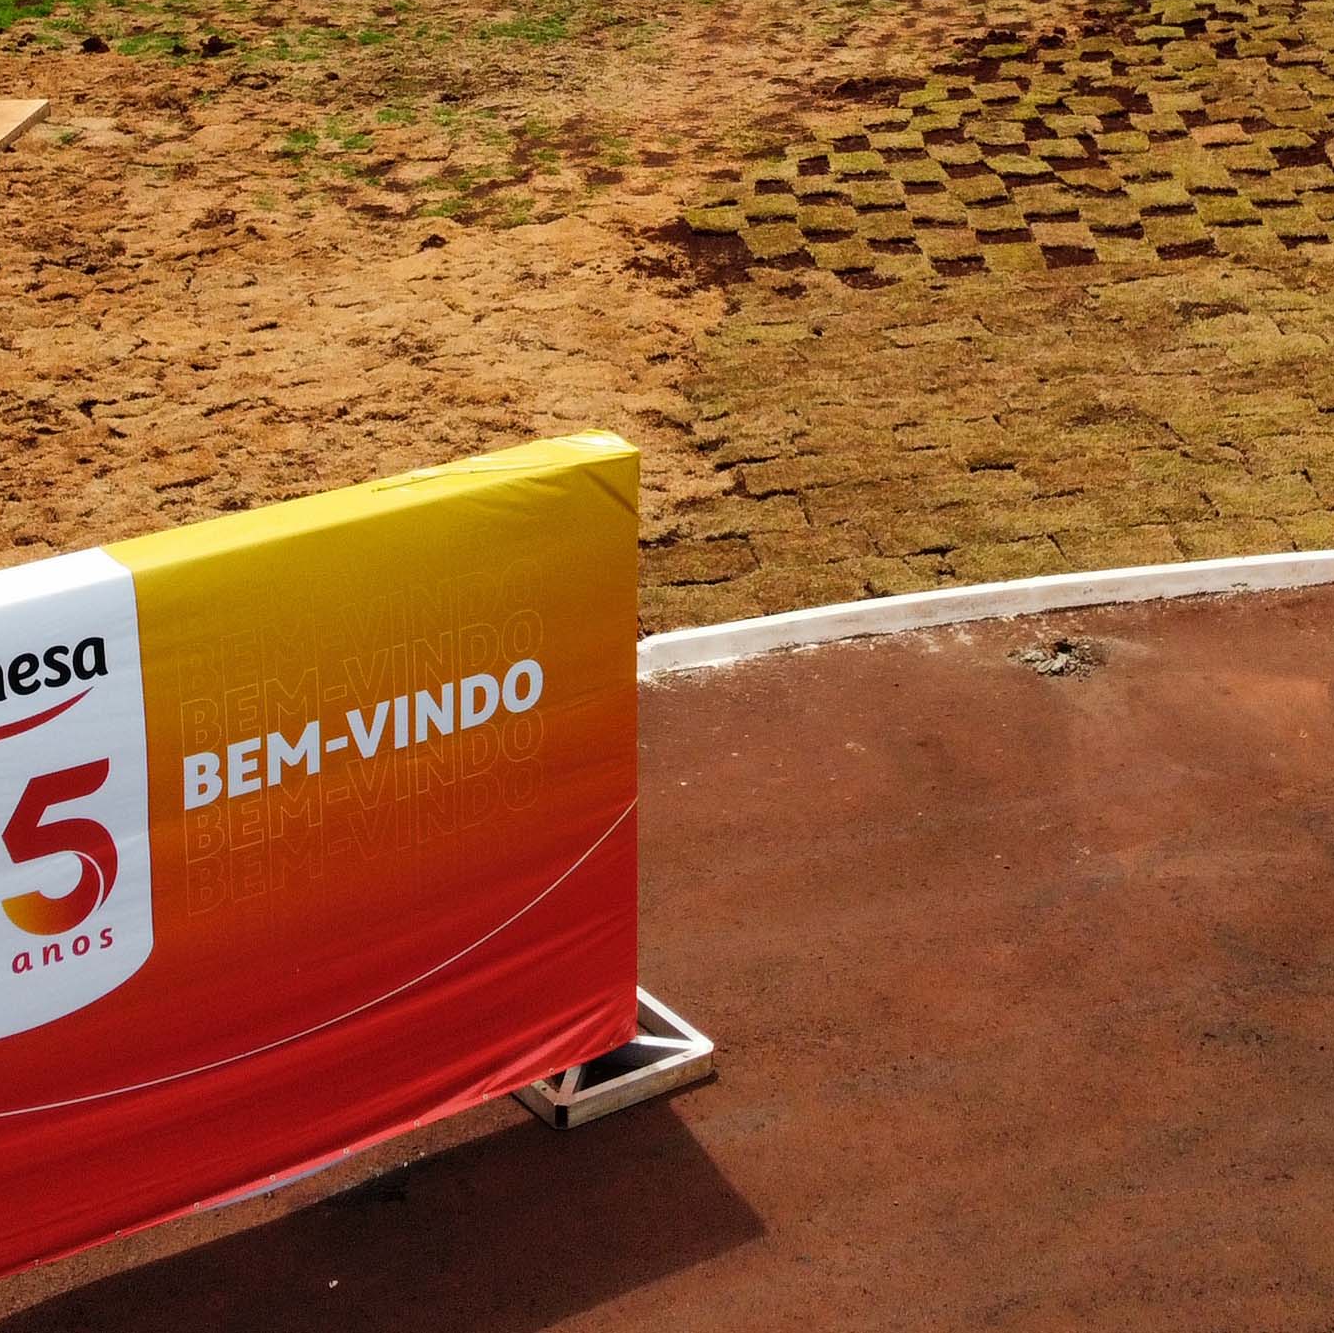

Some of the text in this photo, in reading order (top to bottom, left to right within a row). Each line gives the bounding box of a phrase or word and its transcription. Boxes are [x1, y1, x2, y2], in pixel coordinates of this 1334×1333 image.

[181, 610, 543, 753] BEM-VINDO
[183, 659, 544, 810] BEM-VINDO
[184, 709, 545, 864] BEM-VINDO
[11, 927, 113, 974] anos
